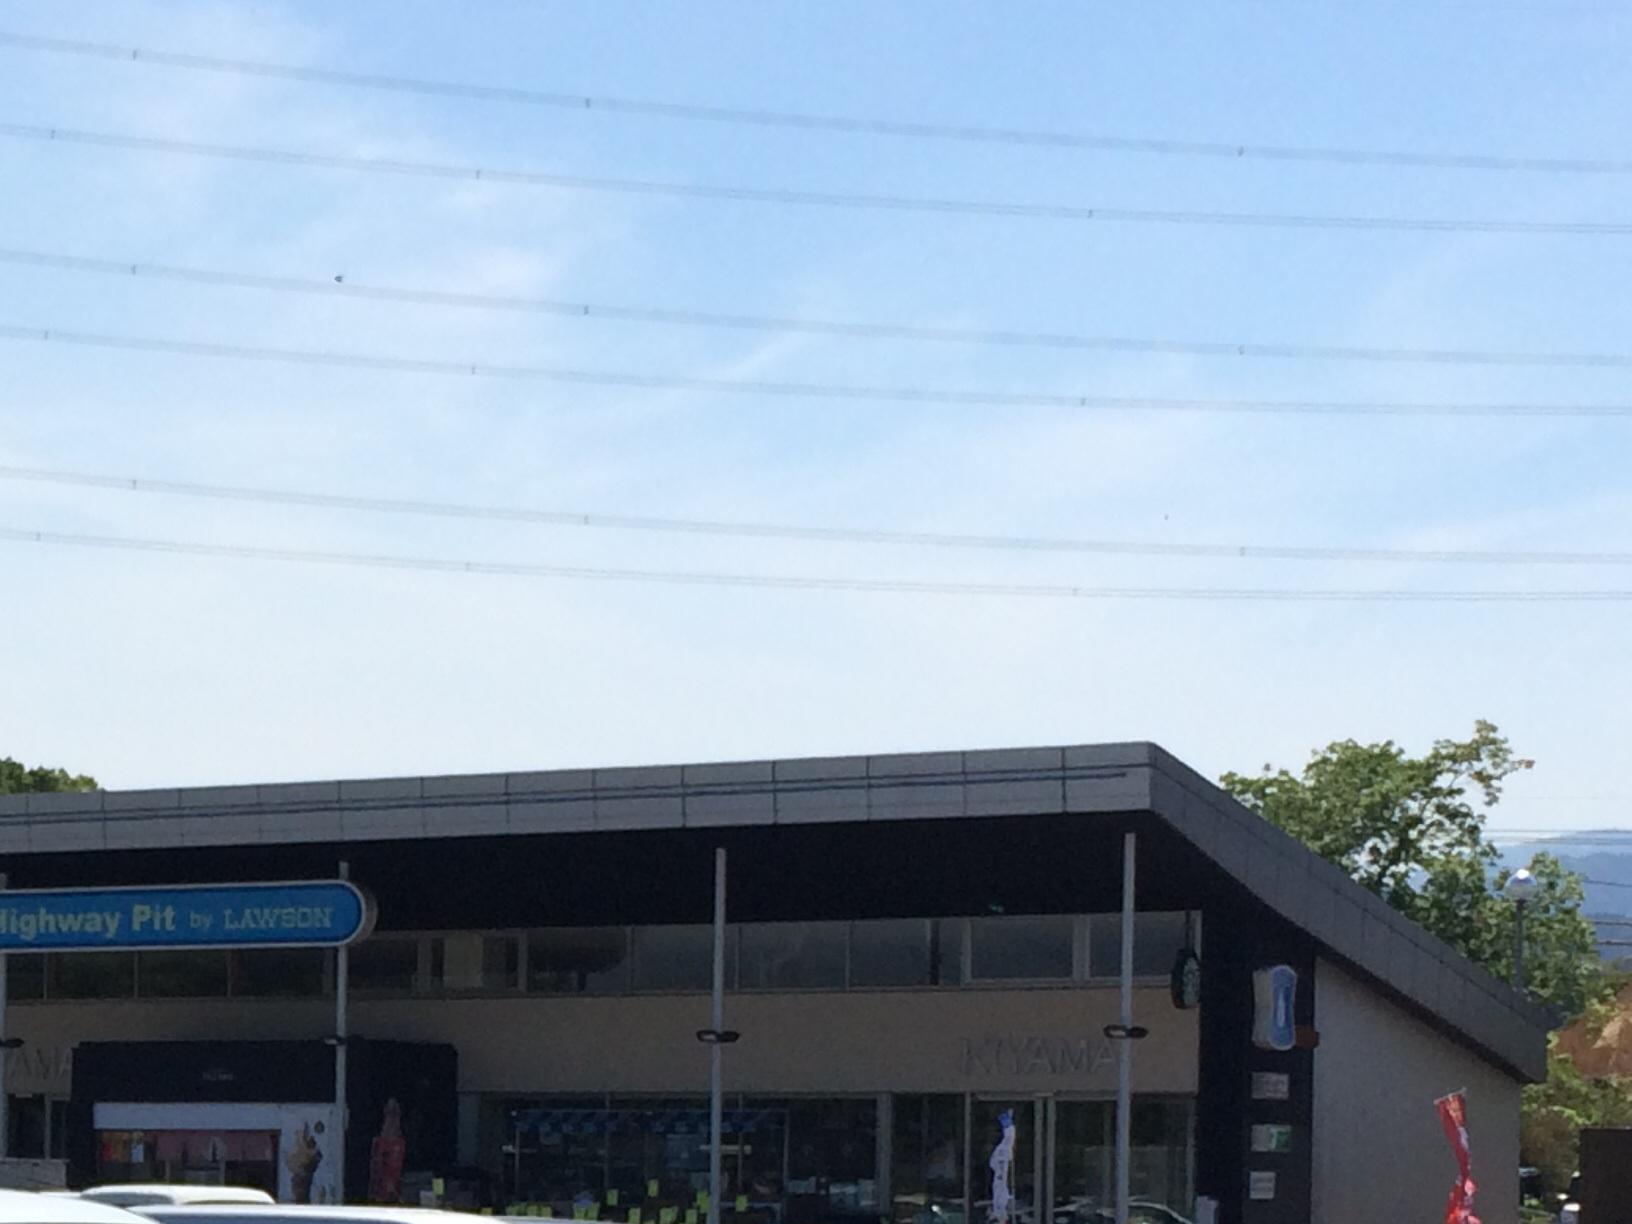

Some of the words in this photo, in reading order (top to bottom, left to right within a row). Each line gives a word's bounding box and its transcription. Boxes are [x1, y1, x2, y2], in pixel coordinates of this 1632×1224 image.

[131, 905, 176, 932] Pit
[189, 910, 214, 932] by
[222, 906, 334, 931] LAWSON
